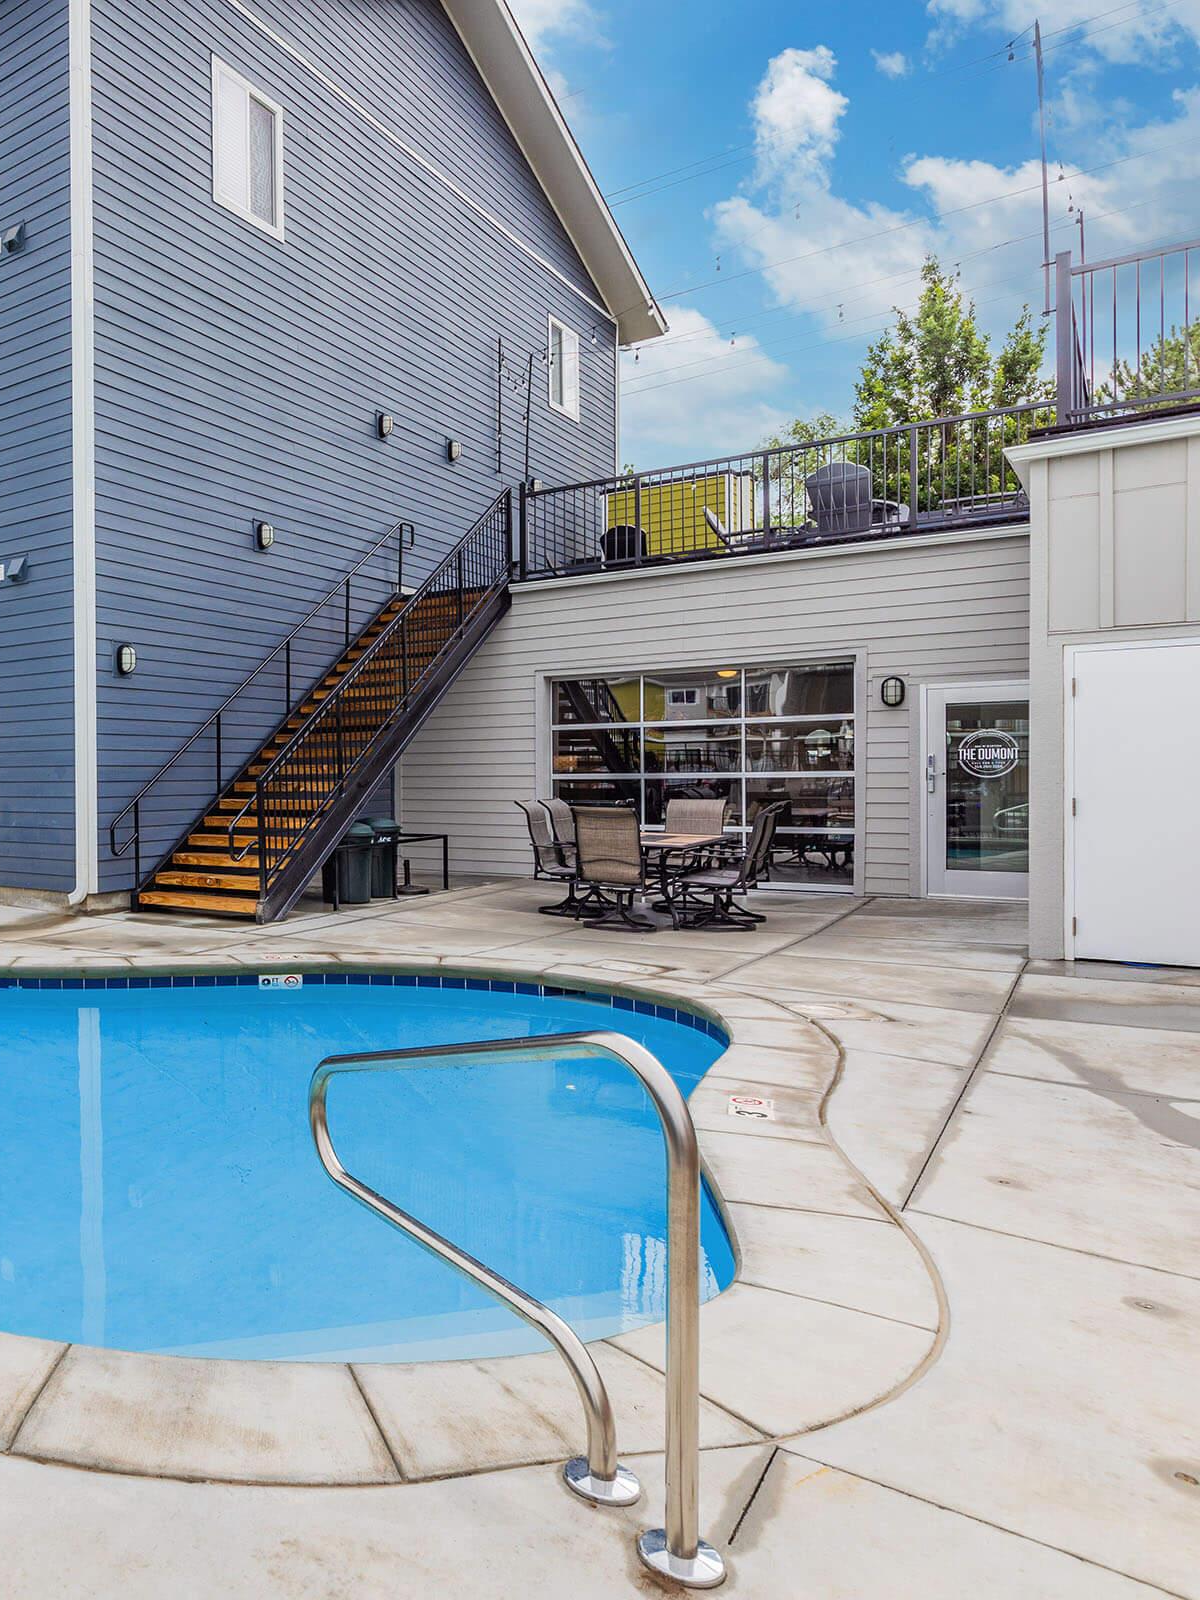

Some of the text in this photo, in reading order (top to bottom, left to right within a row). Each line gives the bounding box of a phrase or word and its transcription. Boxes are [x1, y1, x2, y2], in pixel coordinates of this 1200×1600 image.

[958, 747, 1020, 760] THE DUMONT
[735, 1110, 768, 1118] 3
